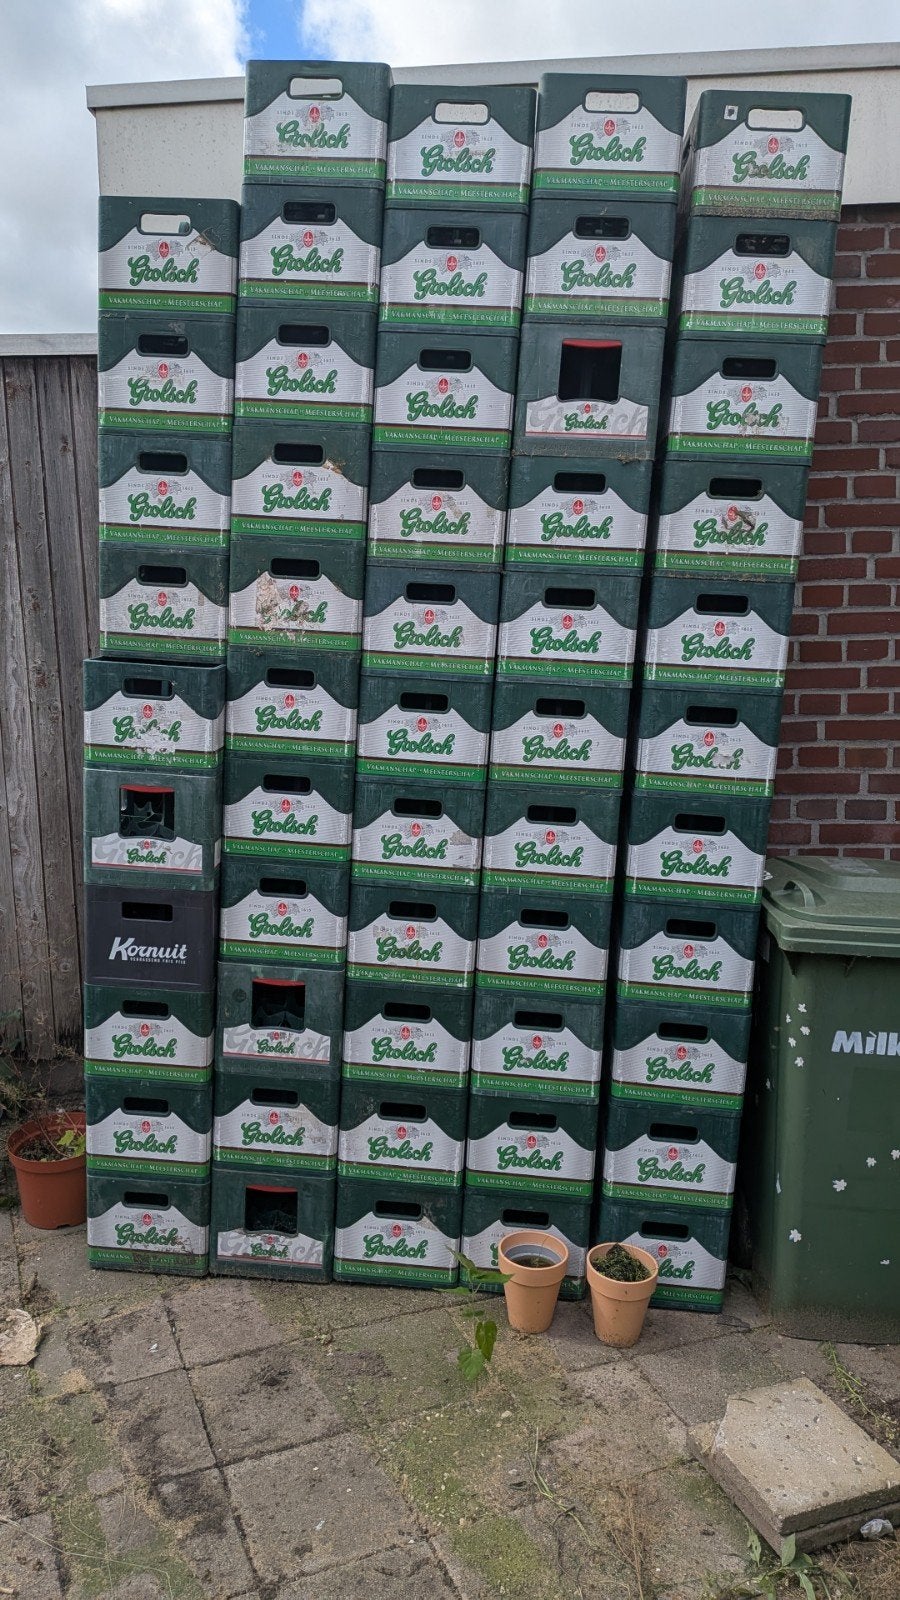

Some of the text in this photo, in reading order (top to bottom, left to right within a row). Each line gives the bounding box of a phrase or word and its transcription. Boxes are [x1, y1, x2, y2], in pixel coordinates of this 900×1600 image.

[276, 120, 350, 150] Grolsch
[420, 144, 495, 176] Grolsch
[570, 133, 646, 165] Grolsch
[732, 151, 809, 183] Grolsch
[128, 254, 198, 286] Grolsch
[270, 244, 343, 275] Grolsch
[413, 268, 486, 300] Grolsch
[561, 259, 636, 291] Grolsch
[720, 276, 796, 308] Grolsch
[127, 376, 197, 405] Grolsch
[266, 365, 337, 395] Grolsch
[406, 391, 478, 421] Grolsch
[564, 413, 609, 431] Grolsch
[127, 492, 196, 521] Grolsch
[261, 483, 331, 512] Grolsch
[400, 508, 470, 536] Grolsch
[540, 512, 612, 541] Grolsch
[693, 518, 768, 548] Grolsch
[127, 603, 194, 630] Grolsch
[393, 621, 462, 649] Grolsch
[530, 626, 601, 654] Grolsch
[681, 633, 754, 661] Grolsch
[255, 705, 322, 732] Grolsch
[387, 728, 454, 755] Grolsch
[522, 735, 591, 762] Grolsch
[671, 743, 743, 770] Grolh
[251, 809, 317, 835] Grolsch
[126, 848, 167, 864] Grolsch
[381, 833, 447, 860] Grolsch
[514, 841, 583, 867] Grolsch
[660, 850, 731, 877] Grolsch
[248, 912, 313, 938] Grolsch
[108, 936, 187, 960] Kornuit
[376, 936, 442, 962] Grolsch
[507, 944, 575, 971] Grolsch
[652, 954, 721, 981] Grolsch
[111, 1033, 176, 1058] Grolsch
[257, 1038, 295, 1054] Grolsch
[371, 1036, 436, 1062] Grolsch
[502, 1045, 569, 1072] Grolsch
[645, 1056, 714, 1083] Grolsch
[113, 1130, 176, 1154] Grolsch
[240, 1121, 304, 1146] Grolsch
[367, 1136, 432, 1162] Grolsch
[497, 1145, 563, 1171] Grolsch
[637, 1157, 704, 1183] Grolsch
[114, 1222, 177, 1246] Grolsch
[363, 1234, 428, 1259] Grolsch
[657, 1258, 695, 1280] lsch
